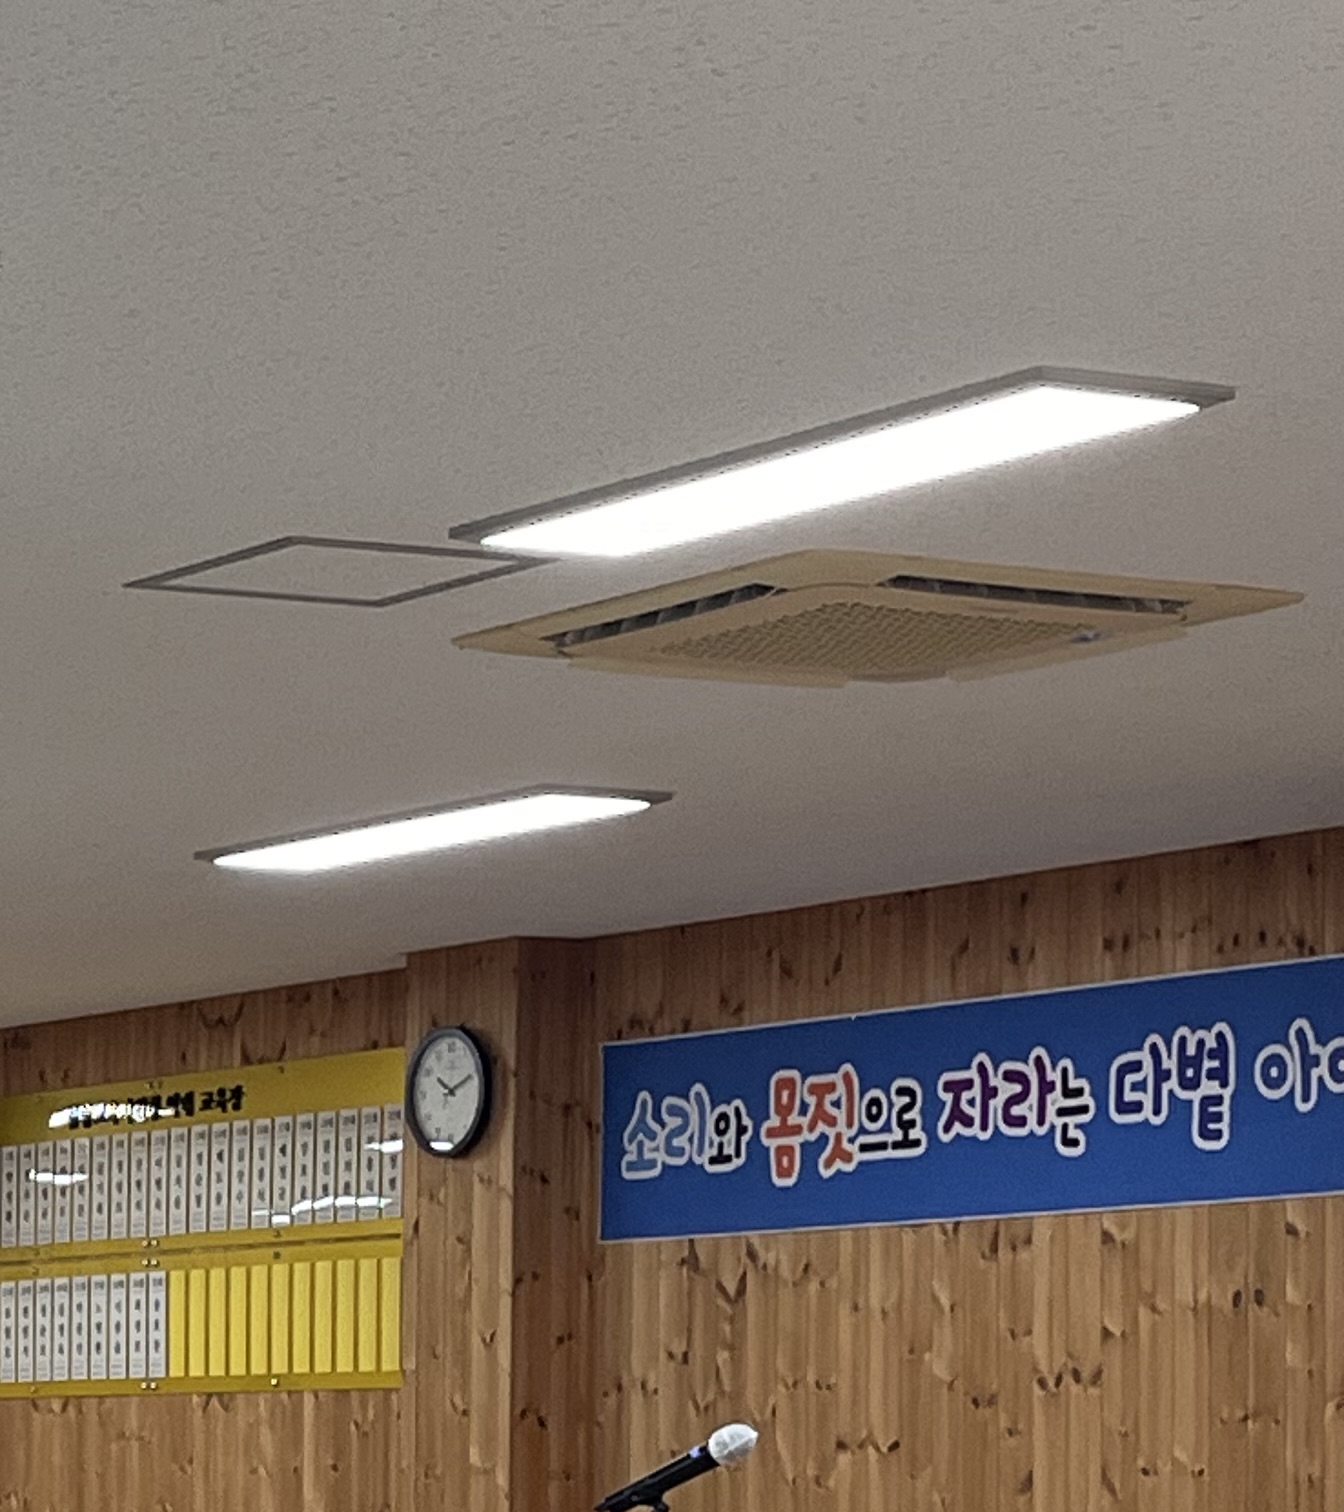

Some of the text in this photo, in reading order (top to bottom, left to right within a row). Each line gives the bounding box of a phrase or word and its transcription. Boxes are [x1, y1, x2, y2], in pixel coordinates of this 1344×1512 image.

[622, 1083, 753, 1181] 소리와
[761, 1062, 927, 1188] 몸짓으로
[937, 1052, 1096, 1158] 자라는
[1109, 1021, 1237, 1152] 다볕
